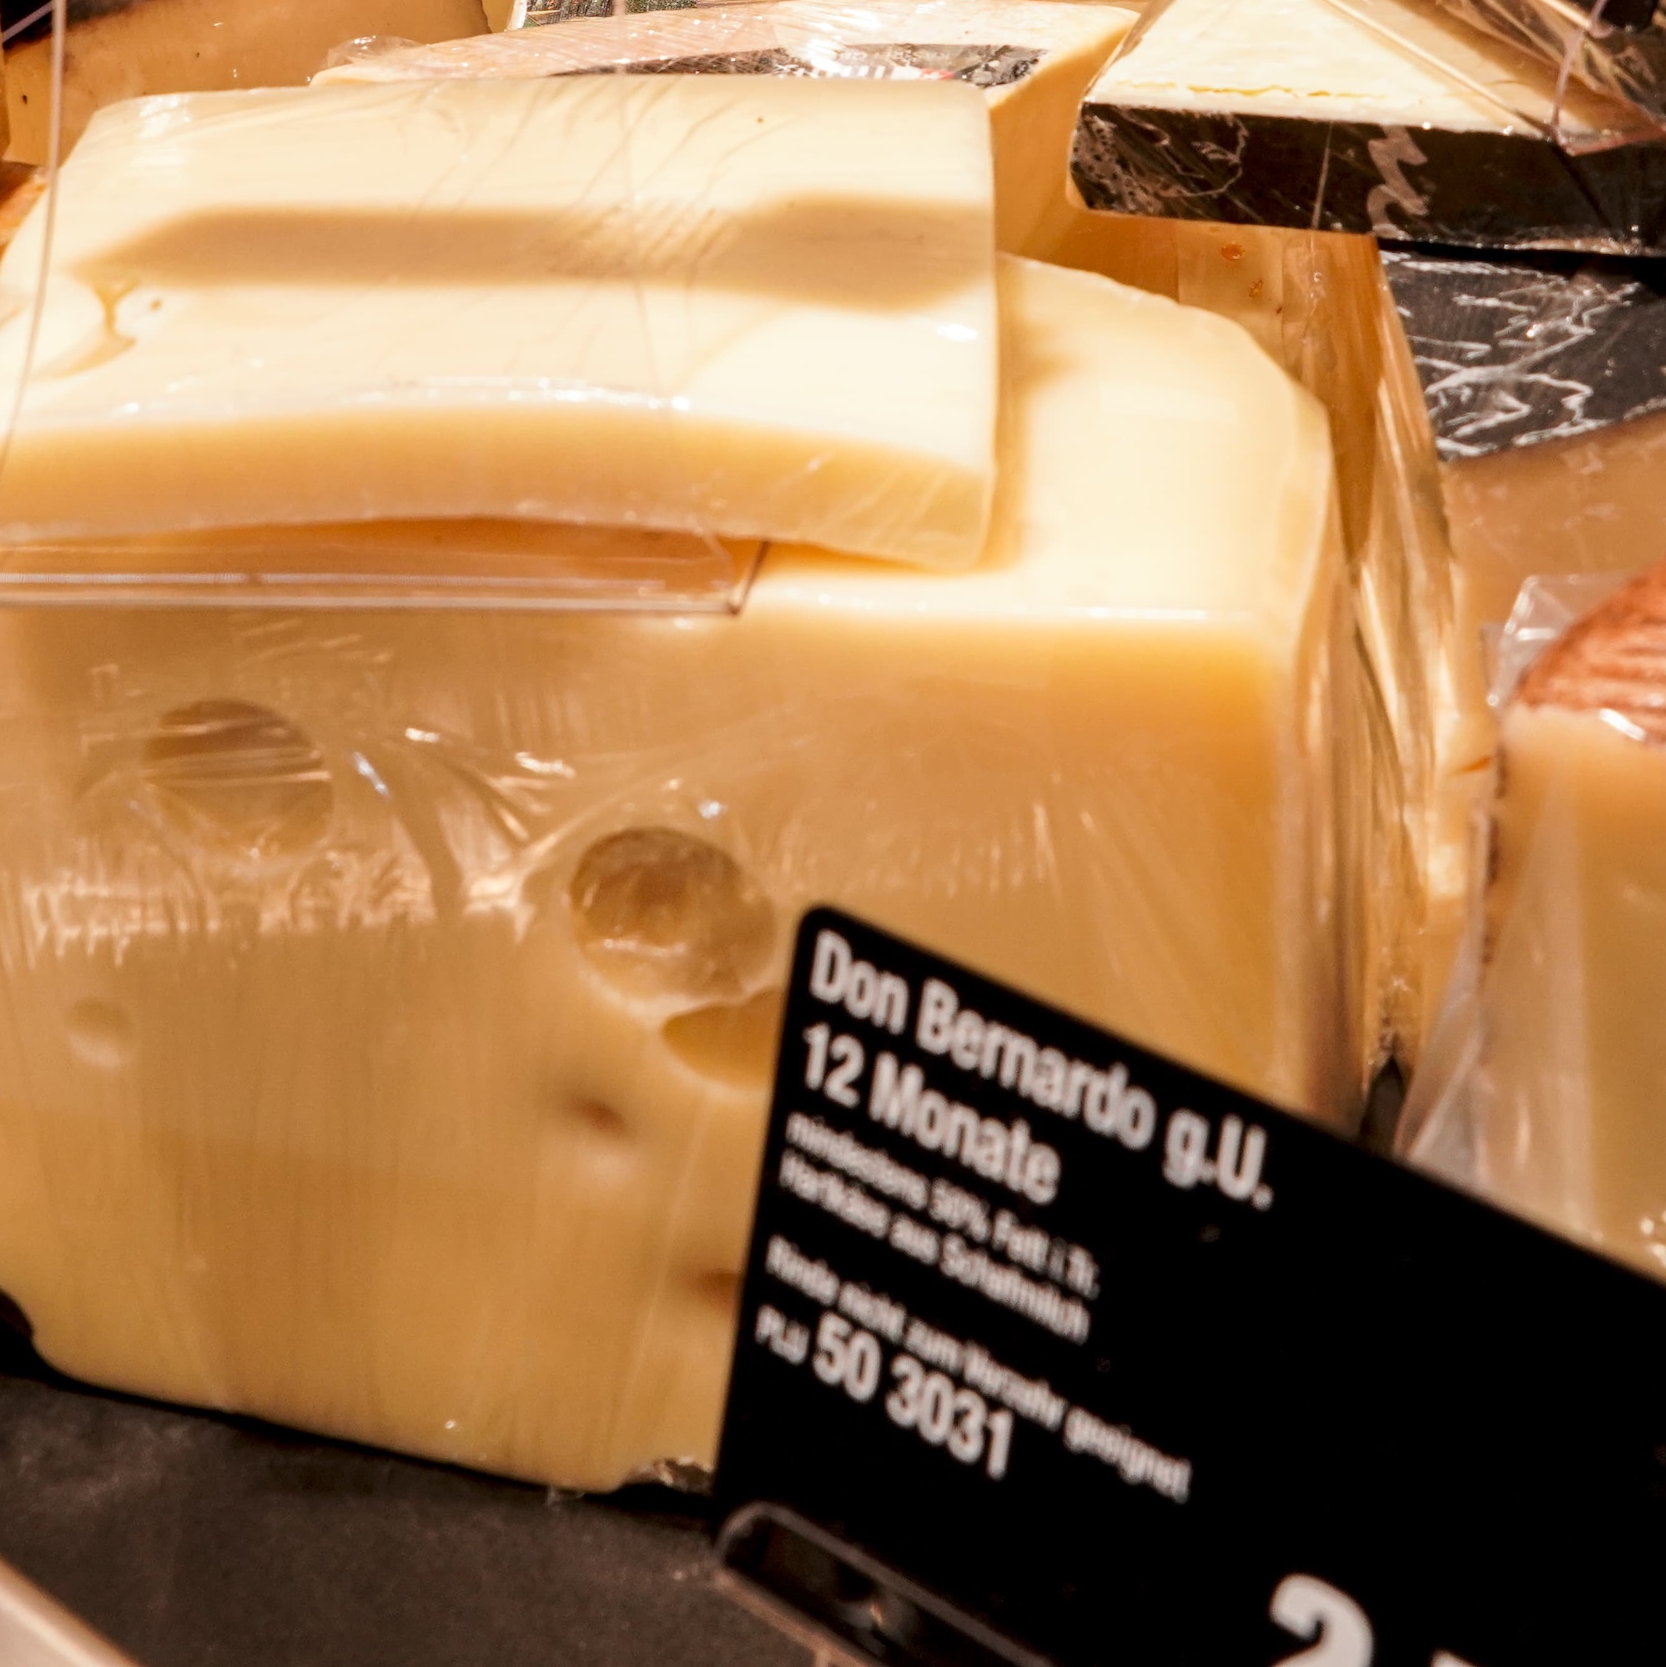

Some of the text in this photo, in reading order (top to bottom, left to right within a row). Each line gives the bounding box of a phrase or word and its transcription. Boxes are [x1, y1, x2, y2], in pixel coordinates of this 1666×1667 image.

[805, 1023, 1060, 1203] 12 Monate
[810, 929, 1272, 1207] Don Bernardo g.U.
